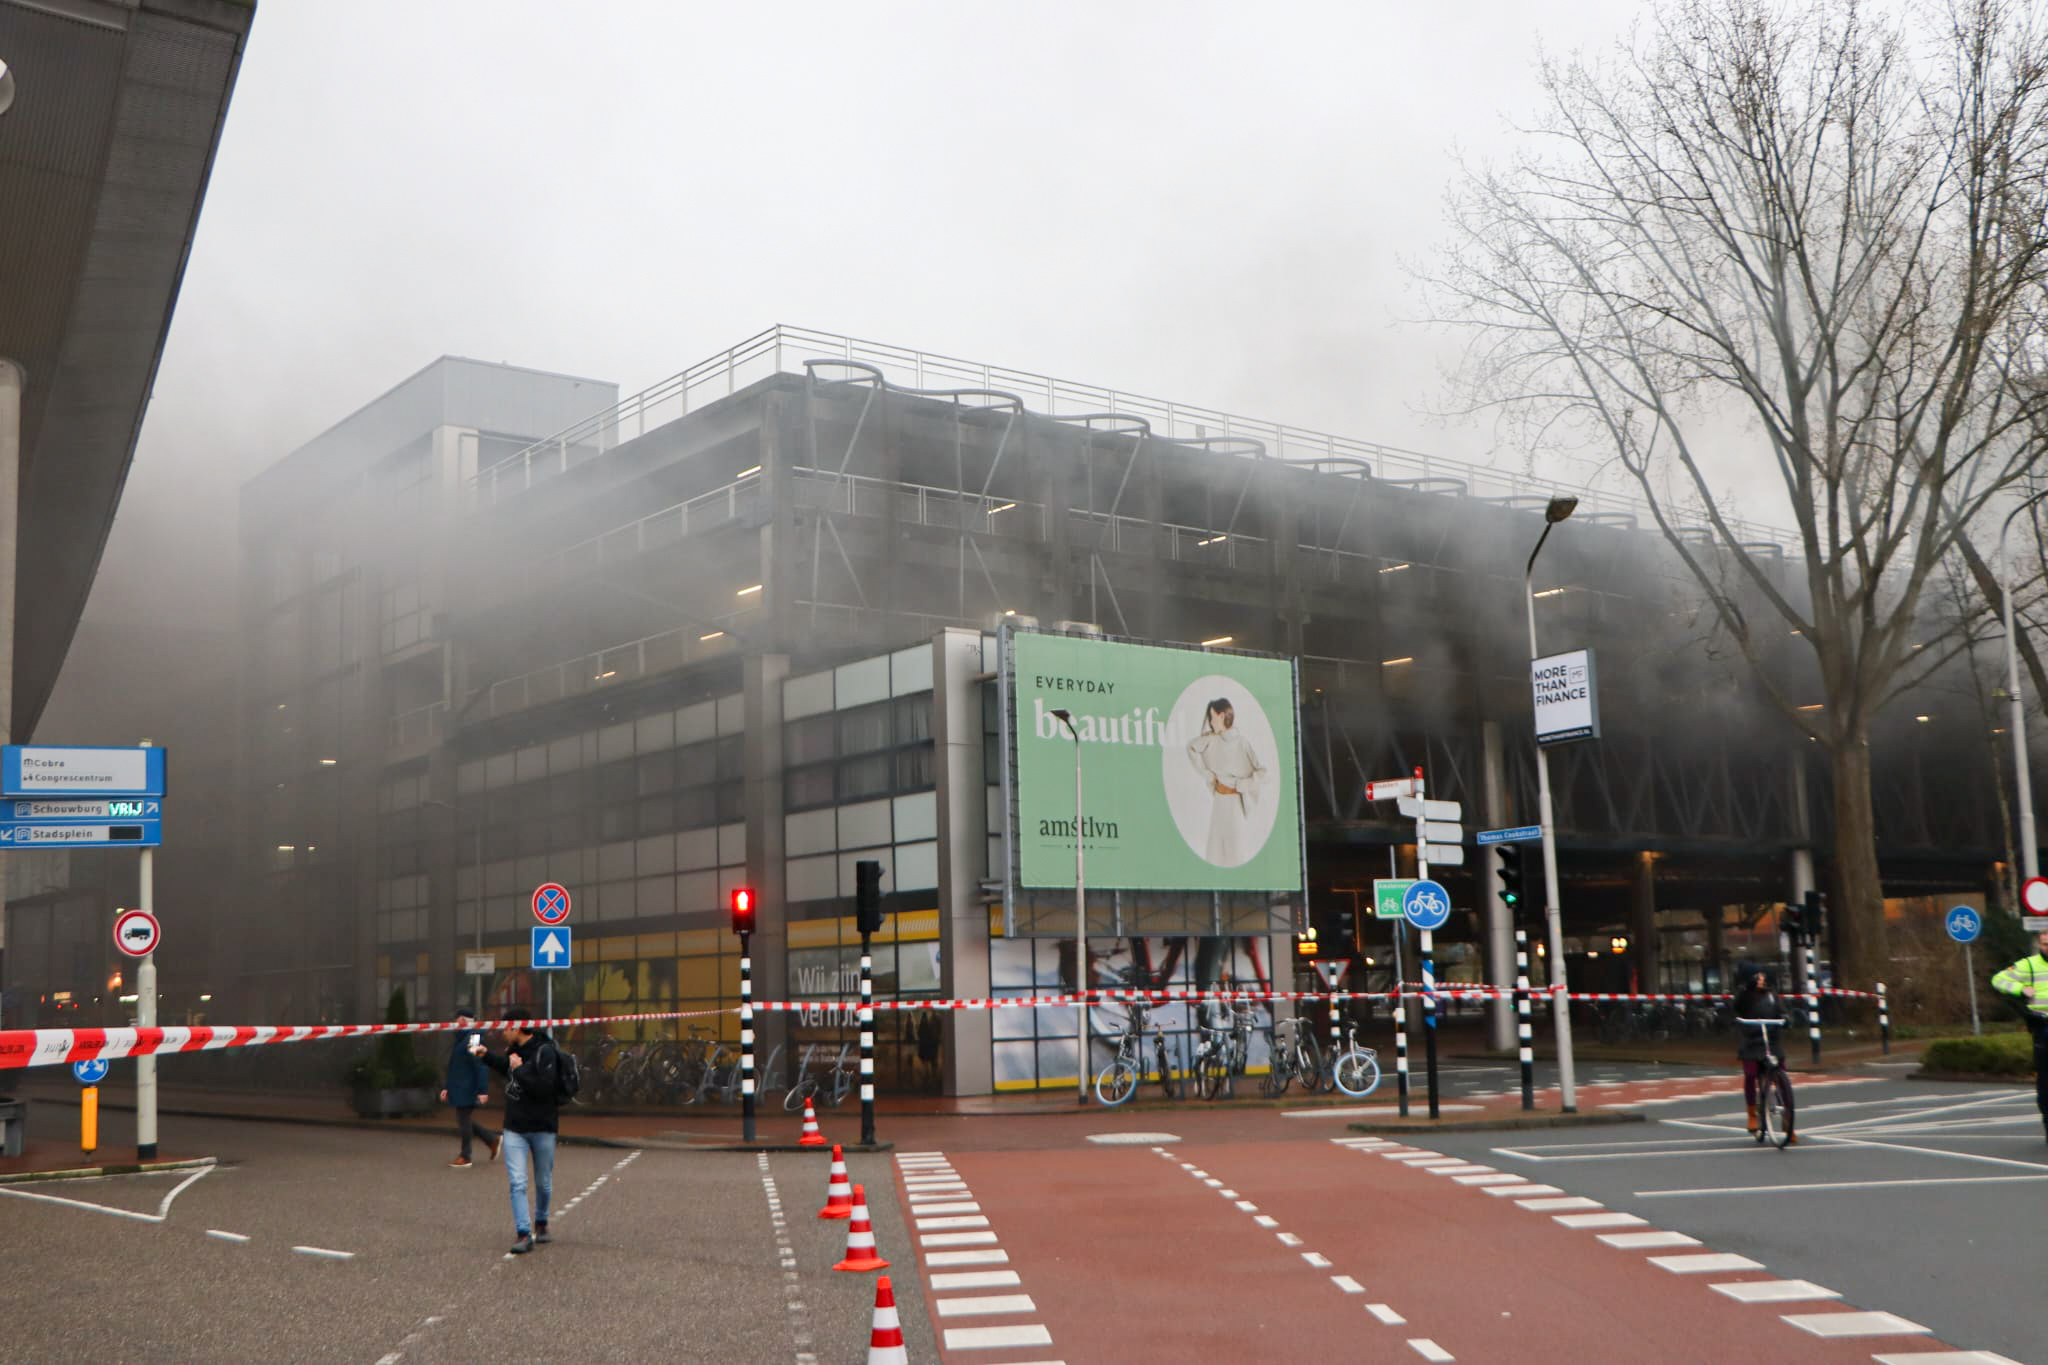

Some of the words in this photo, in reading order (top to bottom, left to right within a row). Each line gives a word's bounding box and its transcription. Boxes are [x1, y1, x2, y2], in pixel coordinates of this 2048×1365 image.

[1534, 665, 1567, 681] MORE
[1035, 675, 1115, 694] EVERYDAY
[1535, 678, 1567, 693] THAN
[1536, 687, 1587, 706] FINANCE
[34, 759, 65, 767] Cobra
[35, 774, 113, 782] Congrescentrum
[33, 804, 102, 814] Schouwburg
[109, 802, 142, 816] VRIJ
[33, 829, 93, 839] Stadsplein
